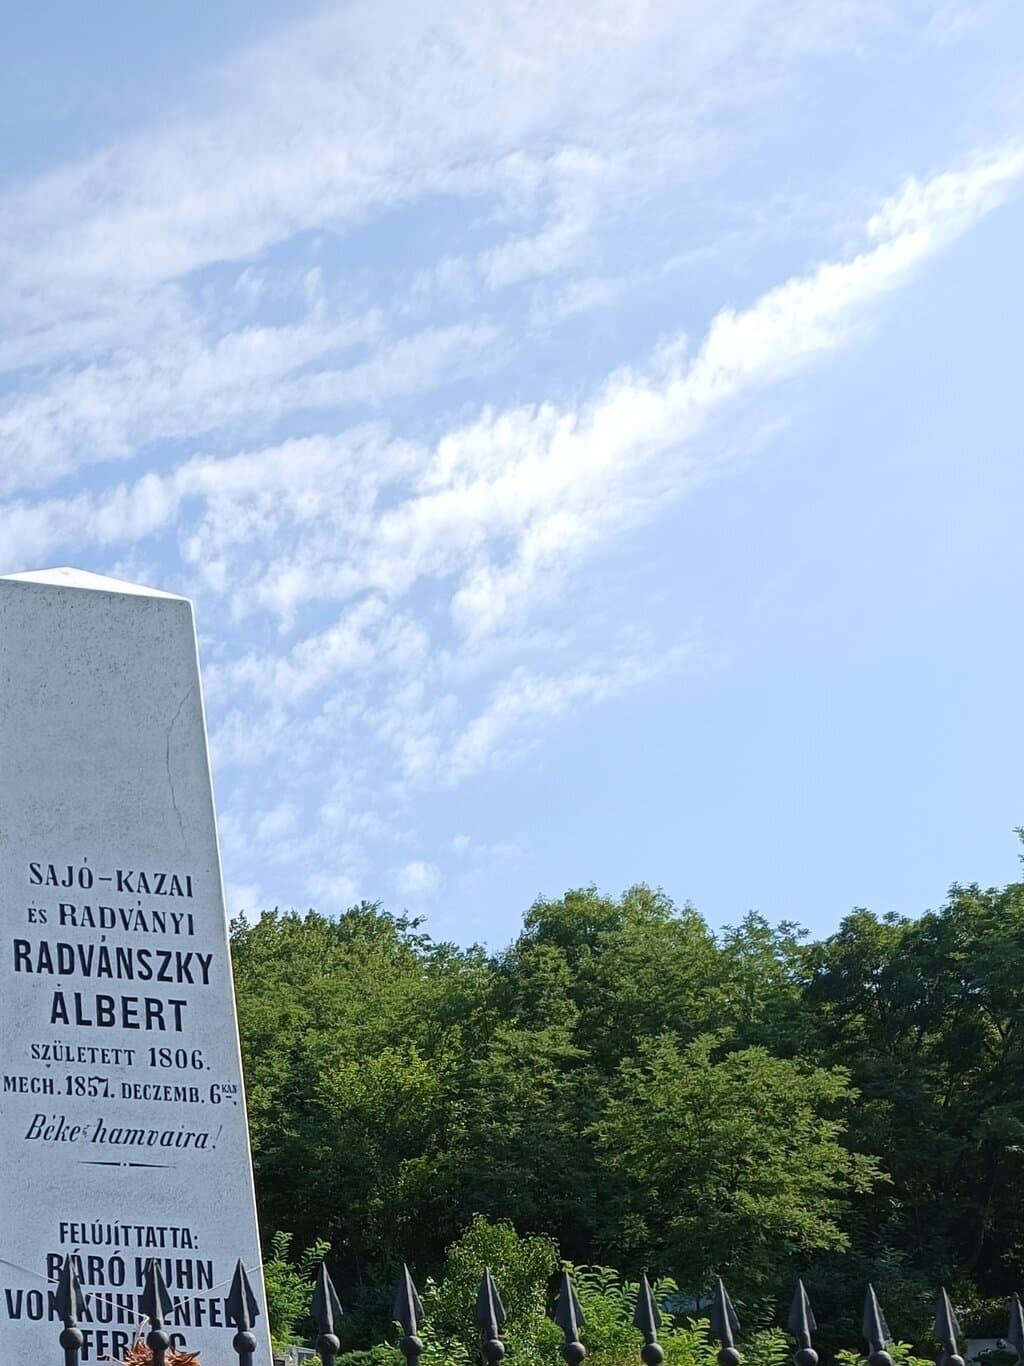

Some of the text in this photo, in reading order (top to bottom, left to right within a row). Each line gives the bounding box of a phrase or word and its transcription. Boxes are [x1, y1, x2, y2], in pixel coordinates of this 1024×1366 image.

[29, 857, 194, 898] SAJÓ-KAZAI
[58, 900, 195, 936] RADVÁNYI
[13, 935, 213, 985] RADVÁNSZKY
[31, 1040, 211, 1071] SZÜLETETT 1806.
[65, 1075, 116, 1099] 1857.
[121, 1082, 205, 1104] DECZEMB.
[59, 1219, 199, 1250] FELÚJÍTTATTA:
